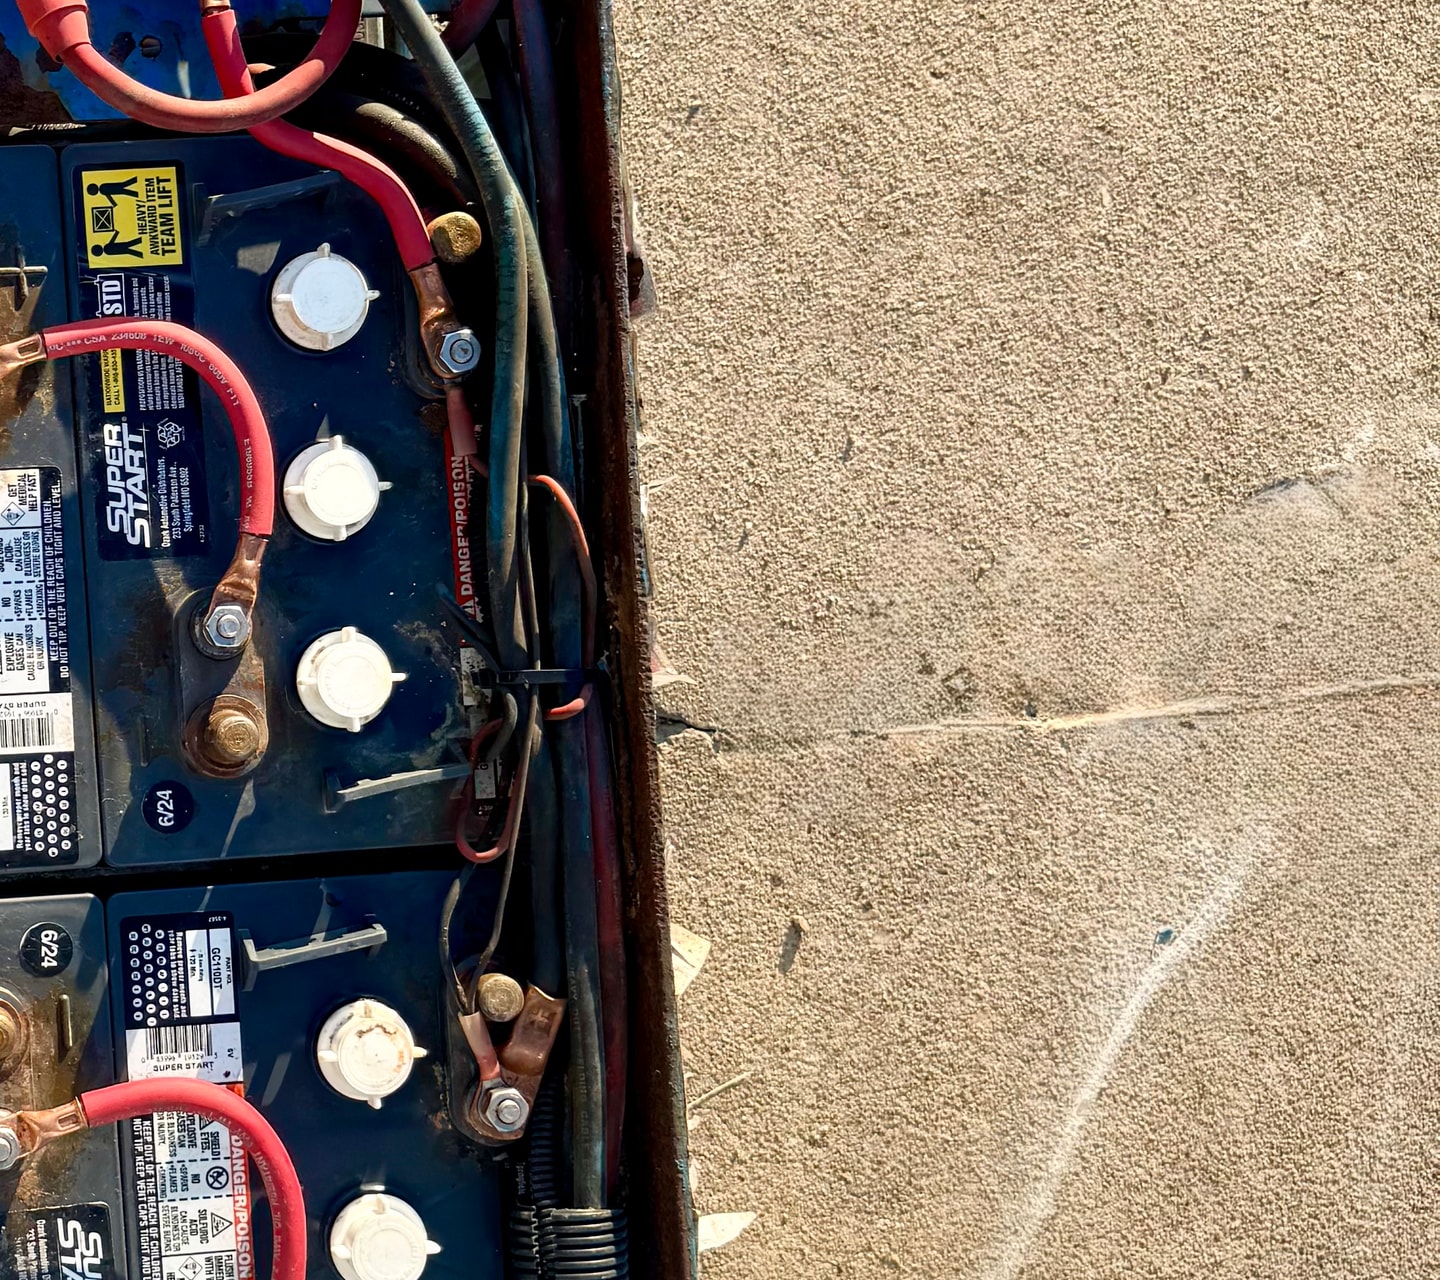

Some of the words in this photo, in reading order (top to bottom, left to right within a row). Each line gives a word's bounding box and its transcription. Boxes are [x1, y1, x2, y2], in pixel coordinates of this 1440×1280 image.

[145, 178, 156, 202] ITEM
[156, 176, 173, 207] LIFT
[136, 199, 147, 235] HEAVY/
[147, 205, 160, 255] AWKWARD
[159, 213, 177, 256] TEAM
[102, 280, 123, 314] STD
[17, 474, 27, 506] MEDICAL
[103, 423, 128, 534] SUPER
[121, 422, 151, 548] START
[8, 484, 17, 498] GET
[28, 493, 38, 512] HELP
[51, 480, 61, 508] LEVEL.
[170, 479, 179, 507] Patterson
[43, 498, 53, 543] CHILDREN.
[53, 510, 61, 528] AND
[158, 496, 169, 529] Automotive
[170, 508, 180, 526] South
[182, 498, 193, 532] Springfield
[53, 531, 63, 555] TIGHT
[160, 531, 171, 547] Ozark
[171, 527, 181, 539] 233
[45, 544, 54, 555] OF
[45, 559, 55, 586] REACH
[55, 558, 64, 580] CAPS
[2, 597, 11, 607] NO
[47, 588, 56, 605] THE
[56, 582, 65, 603] VENT
[48, 607, 56, 617] OF
[57, 606, 66, 626] KEEP
[15, 633, 23, 646] CAN
[48, 620, 57, 637] OUT
[58, 629, 68, 645] TIP.
[5, 632, 15, 671] EXPLOSIVE
[25, 624, 34, 659] BLINDNESS
[49, 641, 59, 661] KEEP
[16, 647, 25, 671] GASES
[59, 646, 68, 663] NOT
[27, 660, 35, 680] CAUSE
[60, 665, 69, 678] DO
[156, 790, 174, 827] 6/24
[41, 930, 59, 968] 6/24
[211, 947, 222, 990] GC110DT
[153, 1063, 183, 1072] SUPER
[185, 1061, 214, 1069] START
[200, 1132, 210, 1153] EYES.
[211, 1131, 221, 1156] SHIELD
[232, 1135, 252, 1278] DANGER/POISON
[225, 1254, 234, 1278] FLUSH
